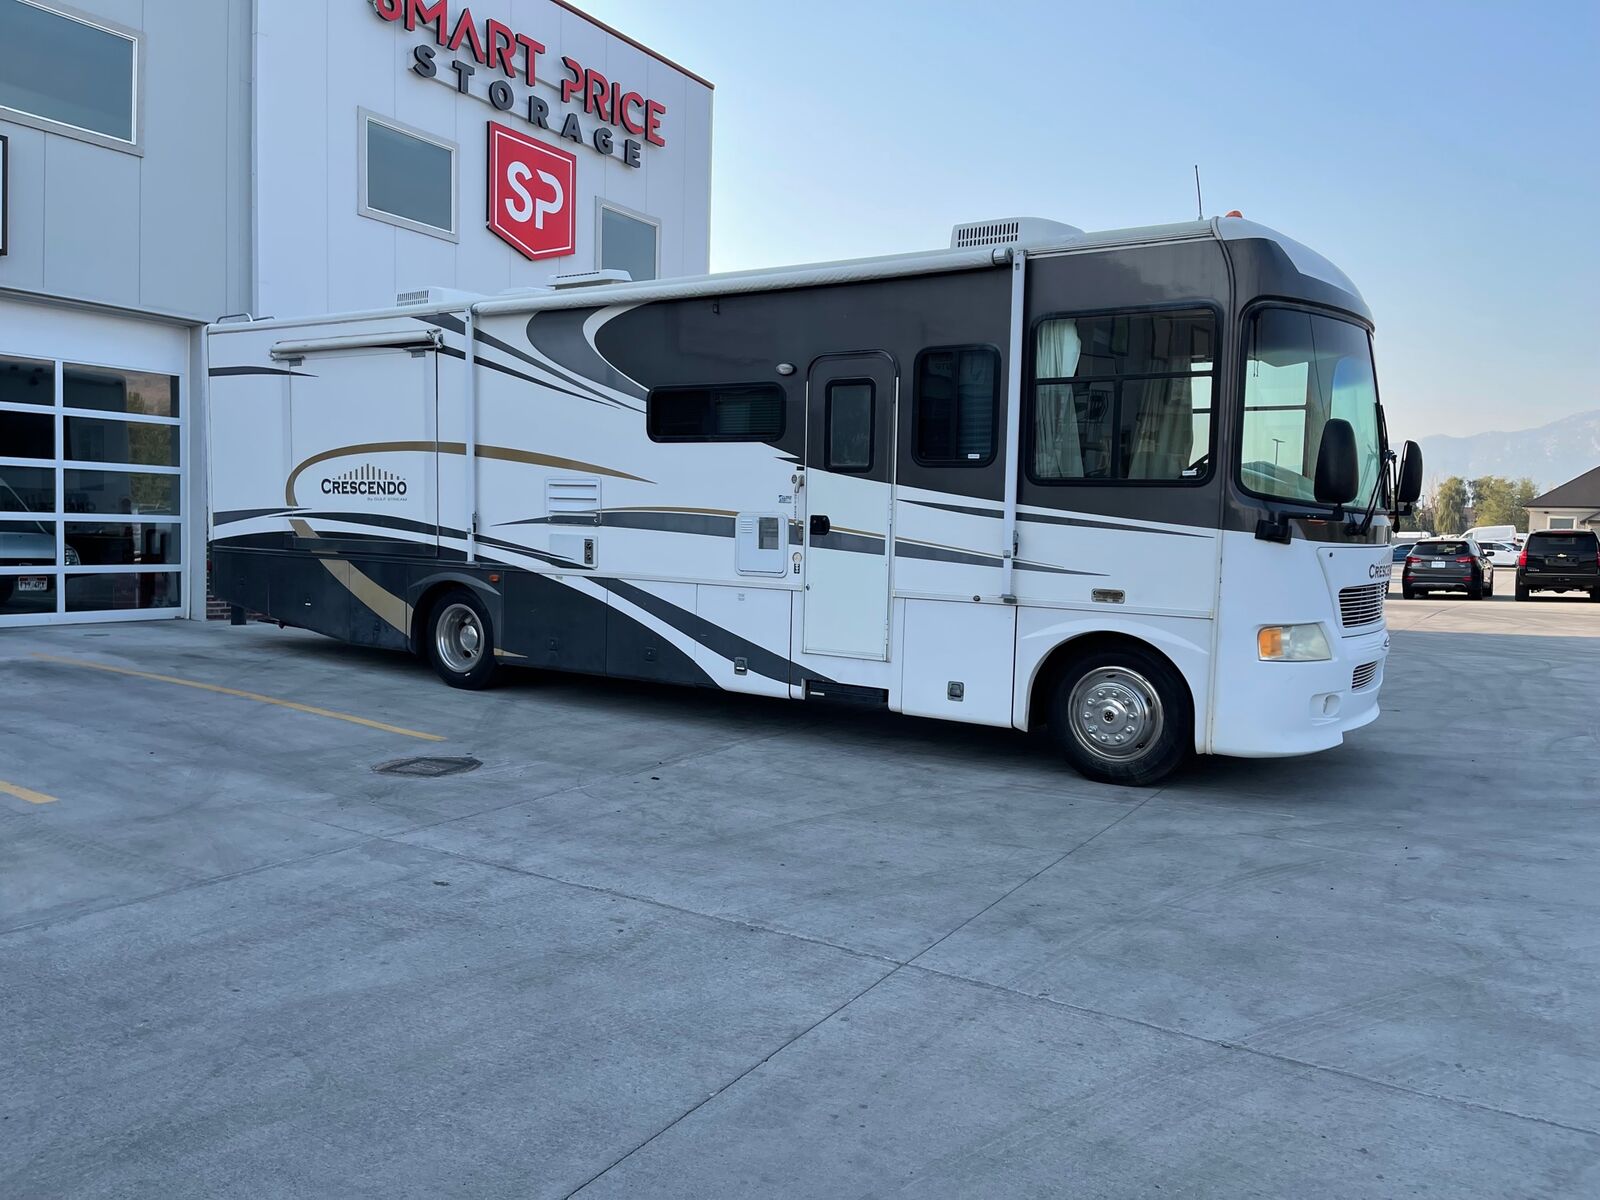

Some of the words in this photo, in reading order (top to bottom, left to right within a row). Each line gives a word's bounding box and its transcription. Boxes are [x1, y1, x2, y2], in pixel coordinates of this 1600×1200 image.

[413, 44, 641, 169] STORAGE
[561, 55, 666, 148] PRICE
[504, 160, 565, 230] SP
[321, 478, 407, 495] CRESCENDO
